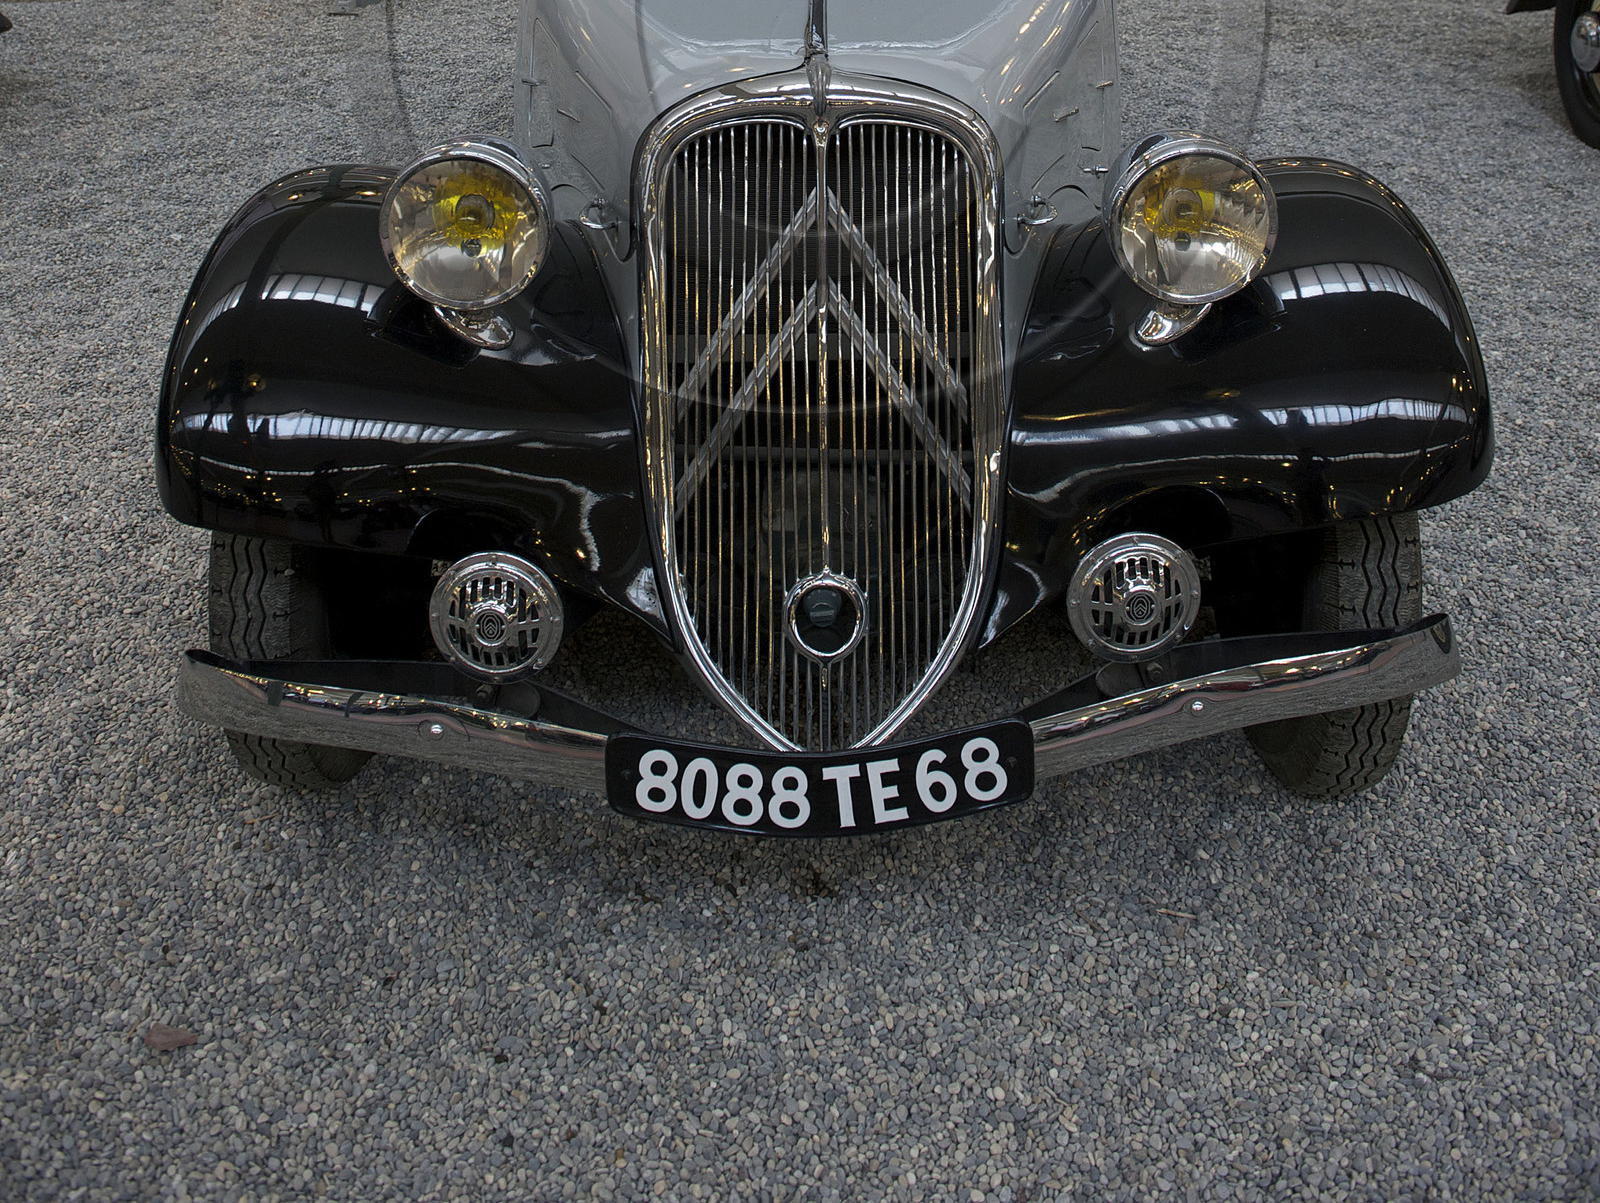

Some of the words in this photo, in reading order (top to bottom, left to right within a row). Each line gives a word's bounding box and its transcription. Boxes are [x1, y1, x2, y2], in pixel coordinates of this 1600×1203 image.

[635, 749, 811, 829] 8088
[822, 757, 909, 829] TE
[915, 737, 1008, 814] 68
